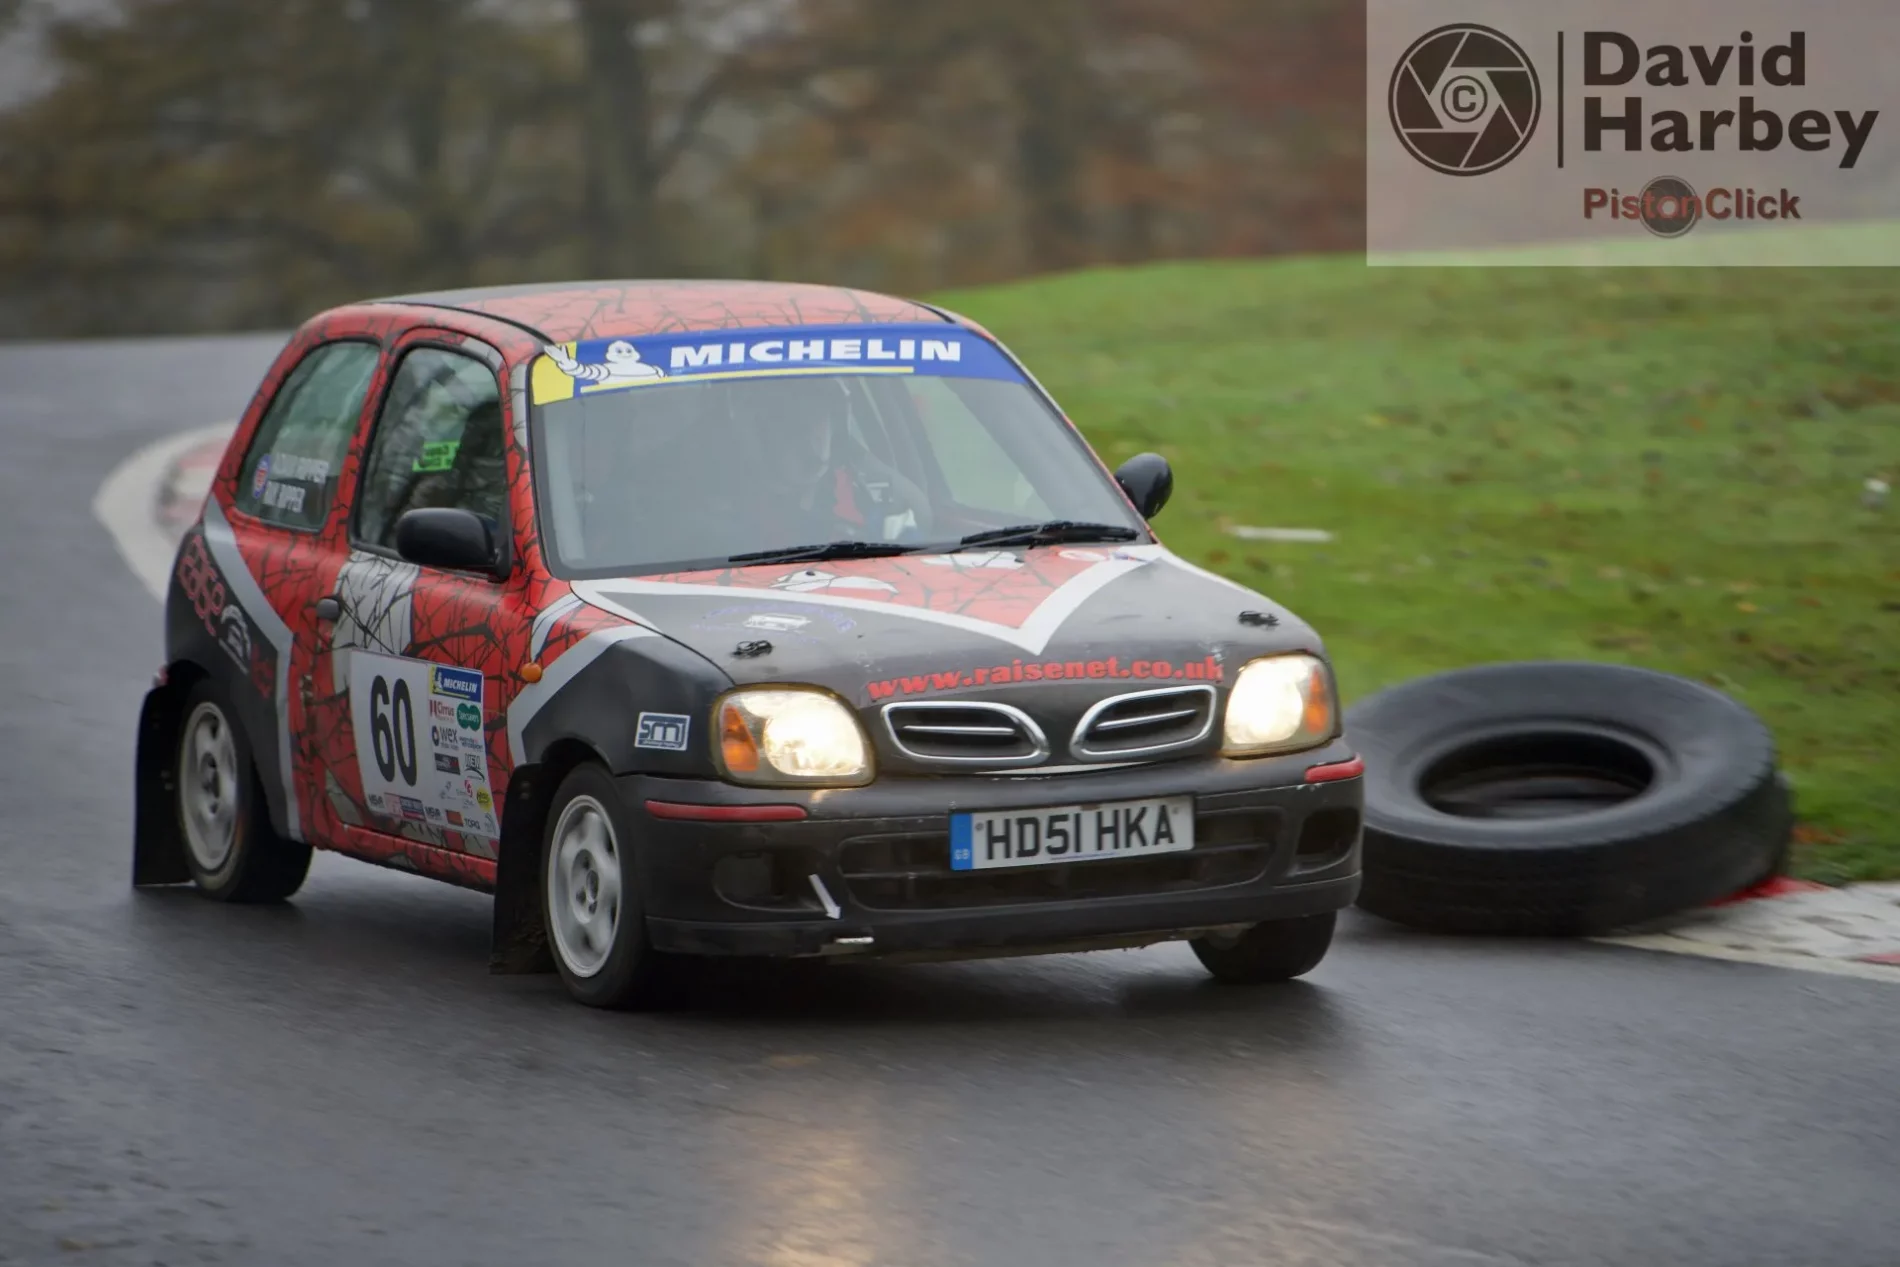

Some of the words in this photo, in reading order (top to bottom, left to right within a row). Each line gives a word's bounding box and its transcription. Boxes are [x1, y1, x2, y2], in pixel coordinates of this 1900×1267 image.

[669, 339, 961, 368] MICHELIN
[443, 677, 478, 694] MICHELIN
[866, 655, 1225, 700] www.raisenet.co.uk
[370, 674, 418, 787] 60
[985, 812, 1082, 860] HD51
[1096, 804, 1175, 851] HKA
